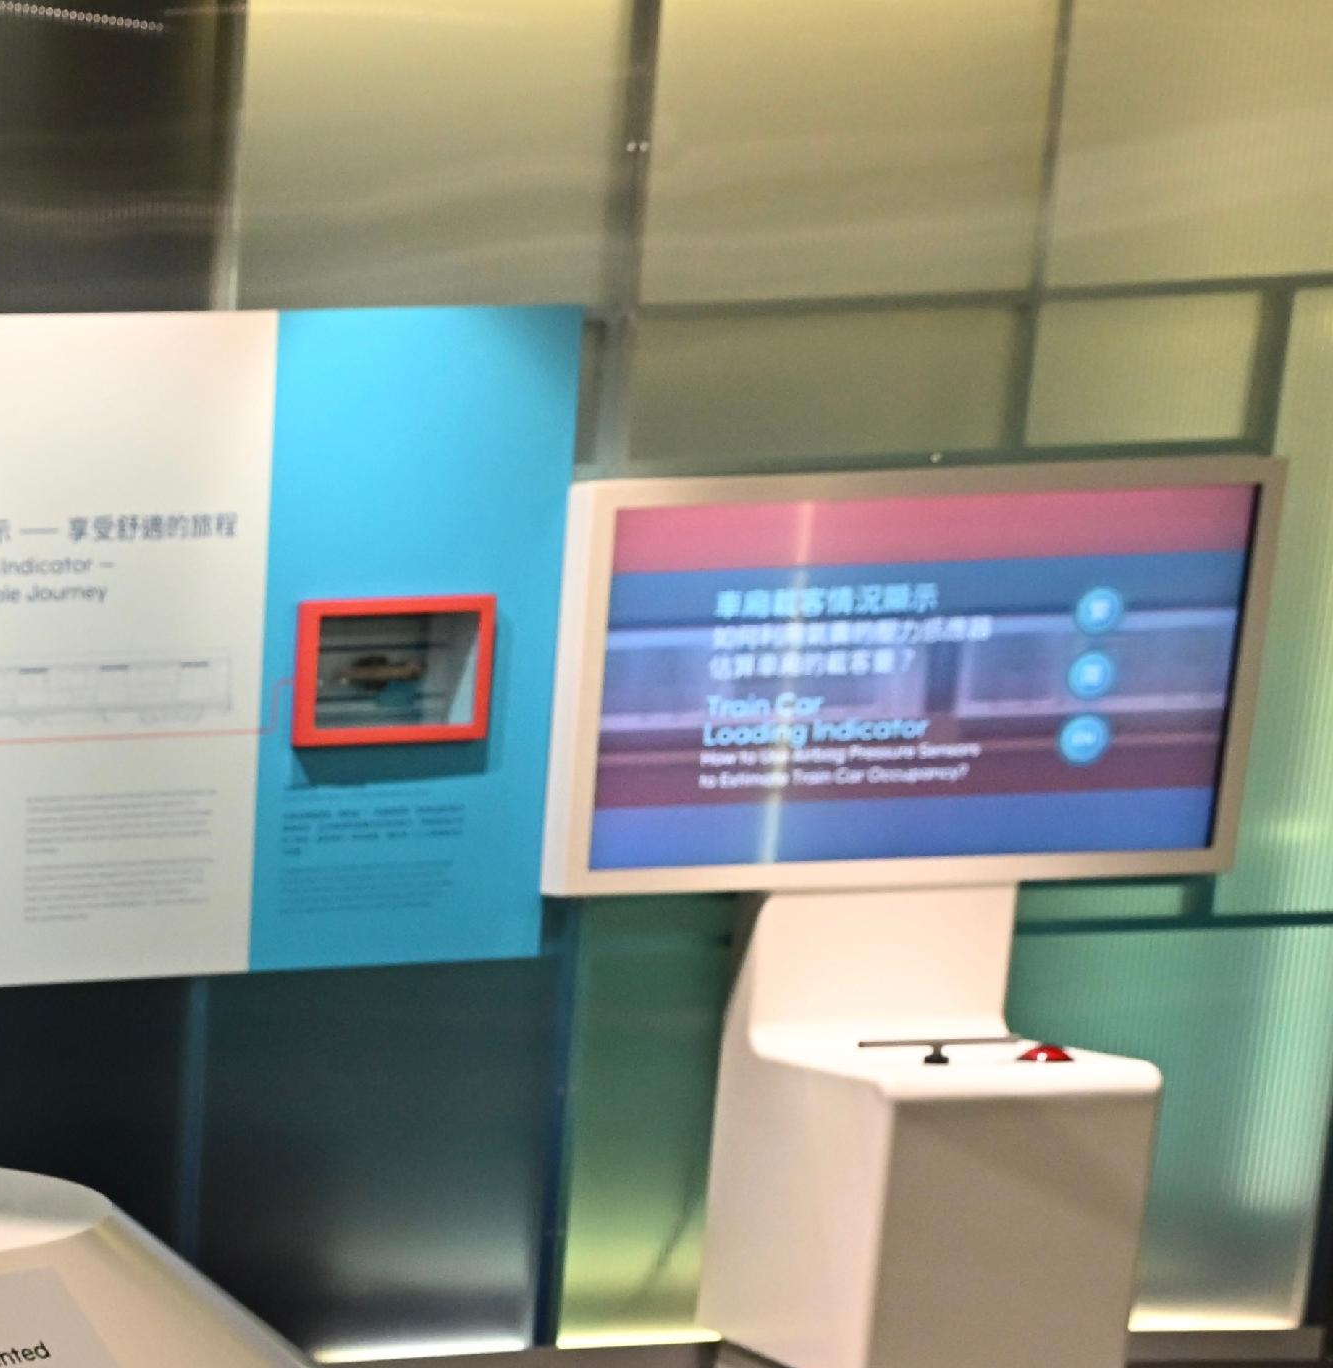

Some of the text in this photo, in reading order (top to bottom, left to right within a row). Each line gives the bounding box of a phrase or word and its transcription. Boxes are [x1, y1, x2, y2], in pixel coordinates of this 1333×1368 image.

[0, 557, 93, 575] Indicator
[25, 585, 107, 602] Journey
[707, 692, 823, 718] Train Car
[702, 718, 928, 748] Loading Indicator
[699, 750, 737, 766] How
[738, 750, 757, 765] to
[847, 744, 916, 760] Pressure
[698, 774, 717, 788] to
[791, 768, 833, 784] Train
[833, 766, 865, 784] Car
